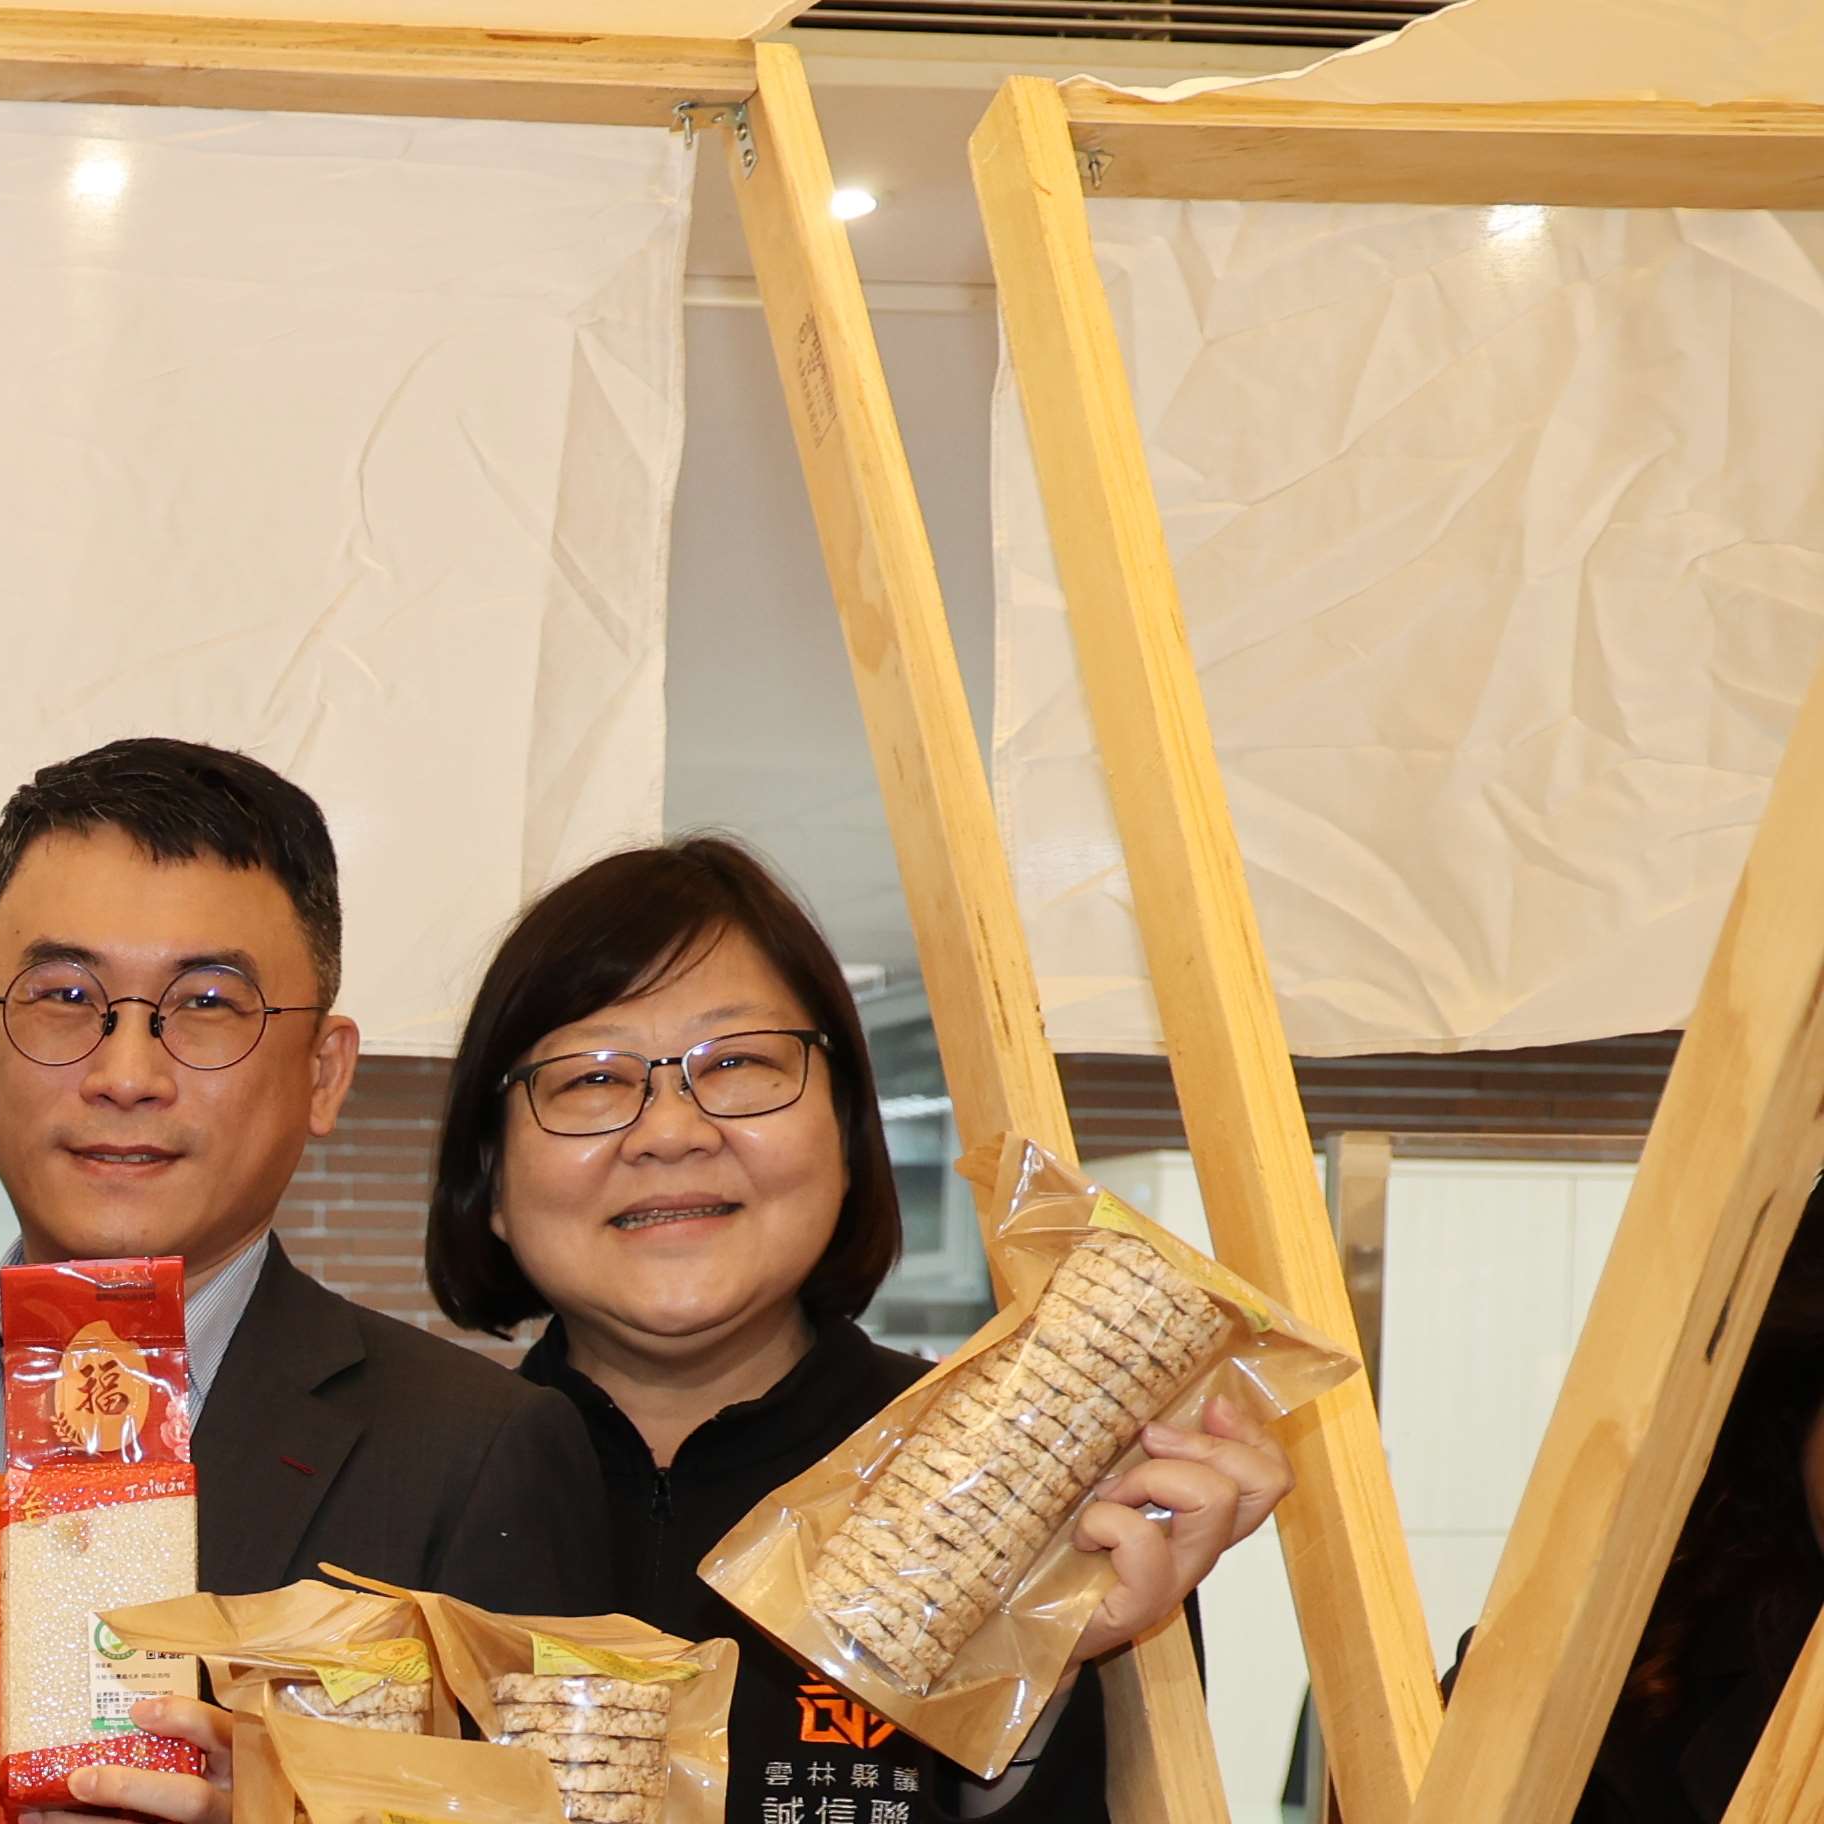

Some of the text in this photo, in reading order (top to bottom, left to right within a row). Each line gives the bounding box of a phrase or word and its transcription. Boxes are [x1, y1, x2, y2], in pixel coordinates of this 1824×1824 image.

[75, 1361, 130, 1417] 福
[125, 1479, 186, 1499] Taiwan
[764, 1760, 920, 1793] 雲林縣議
